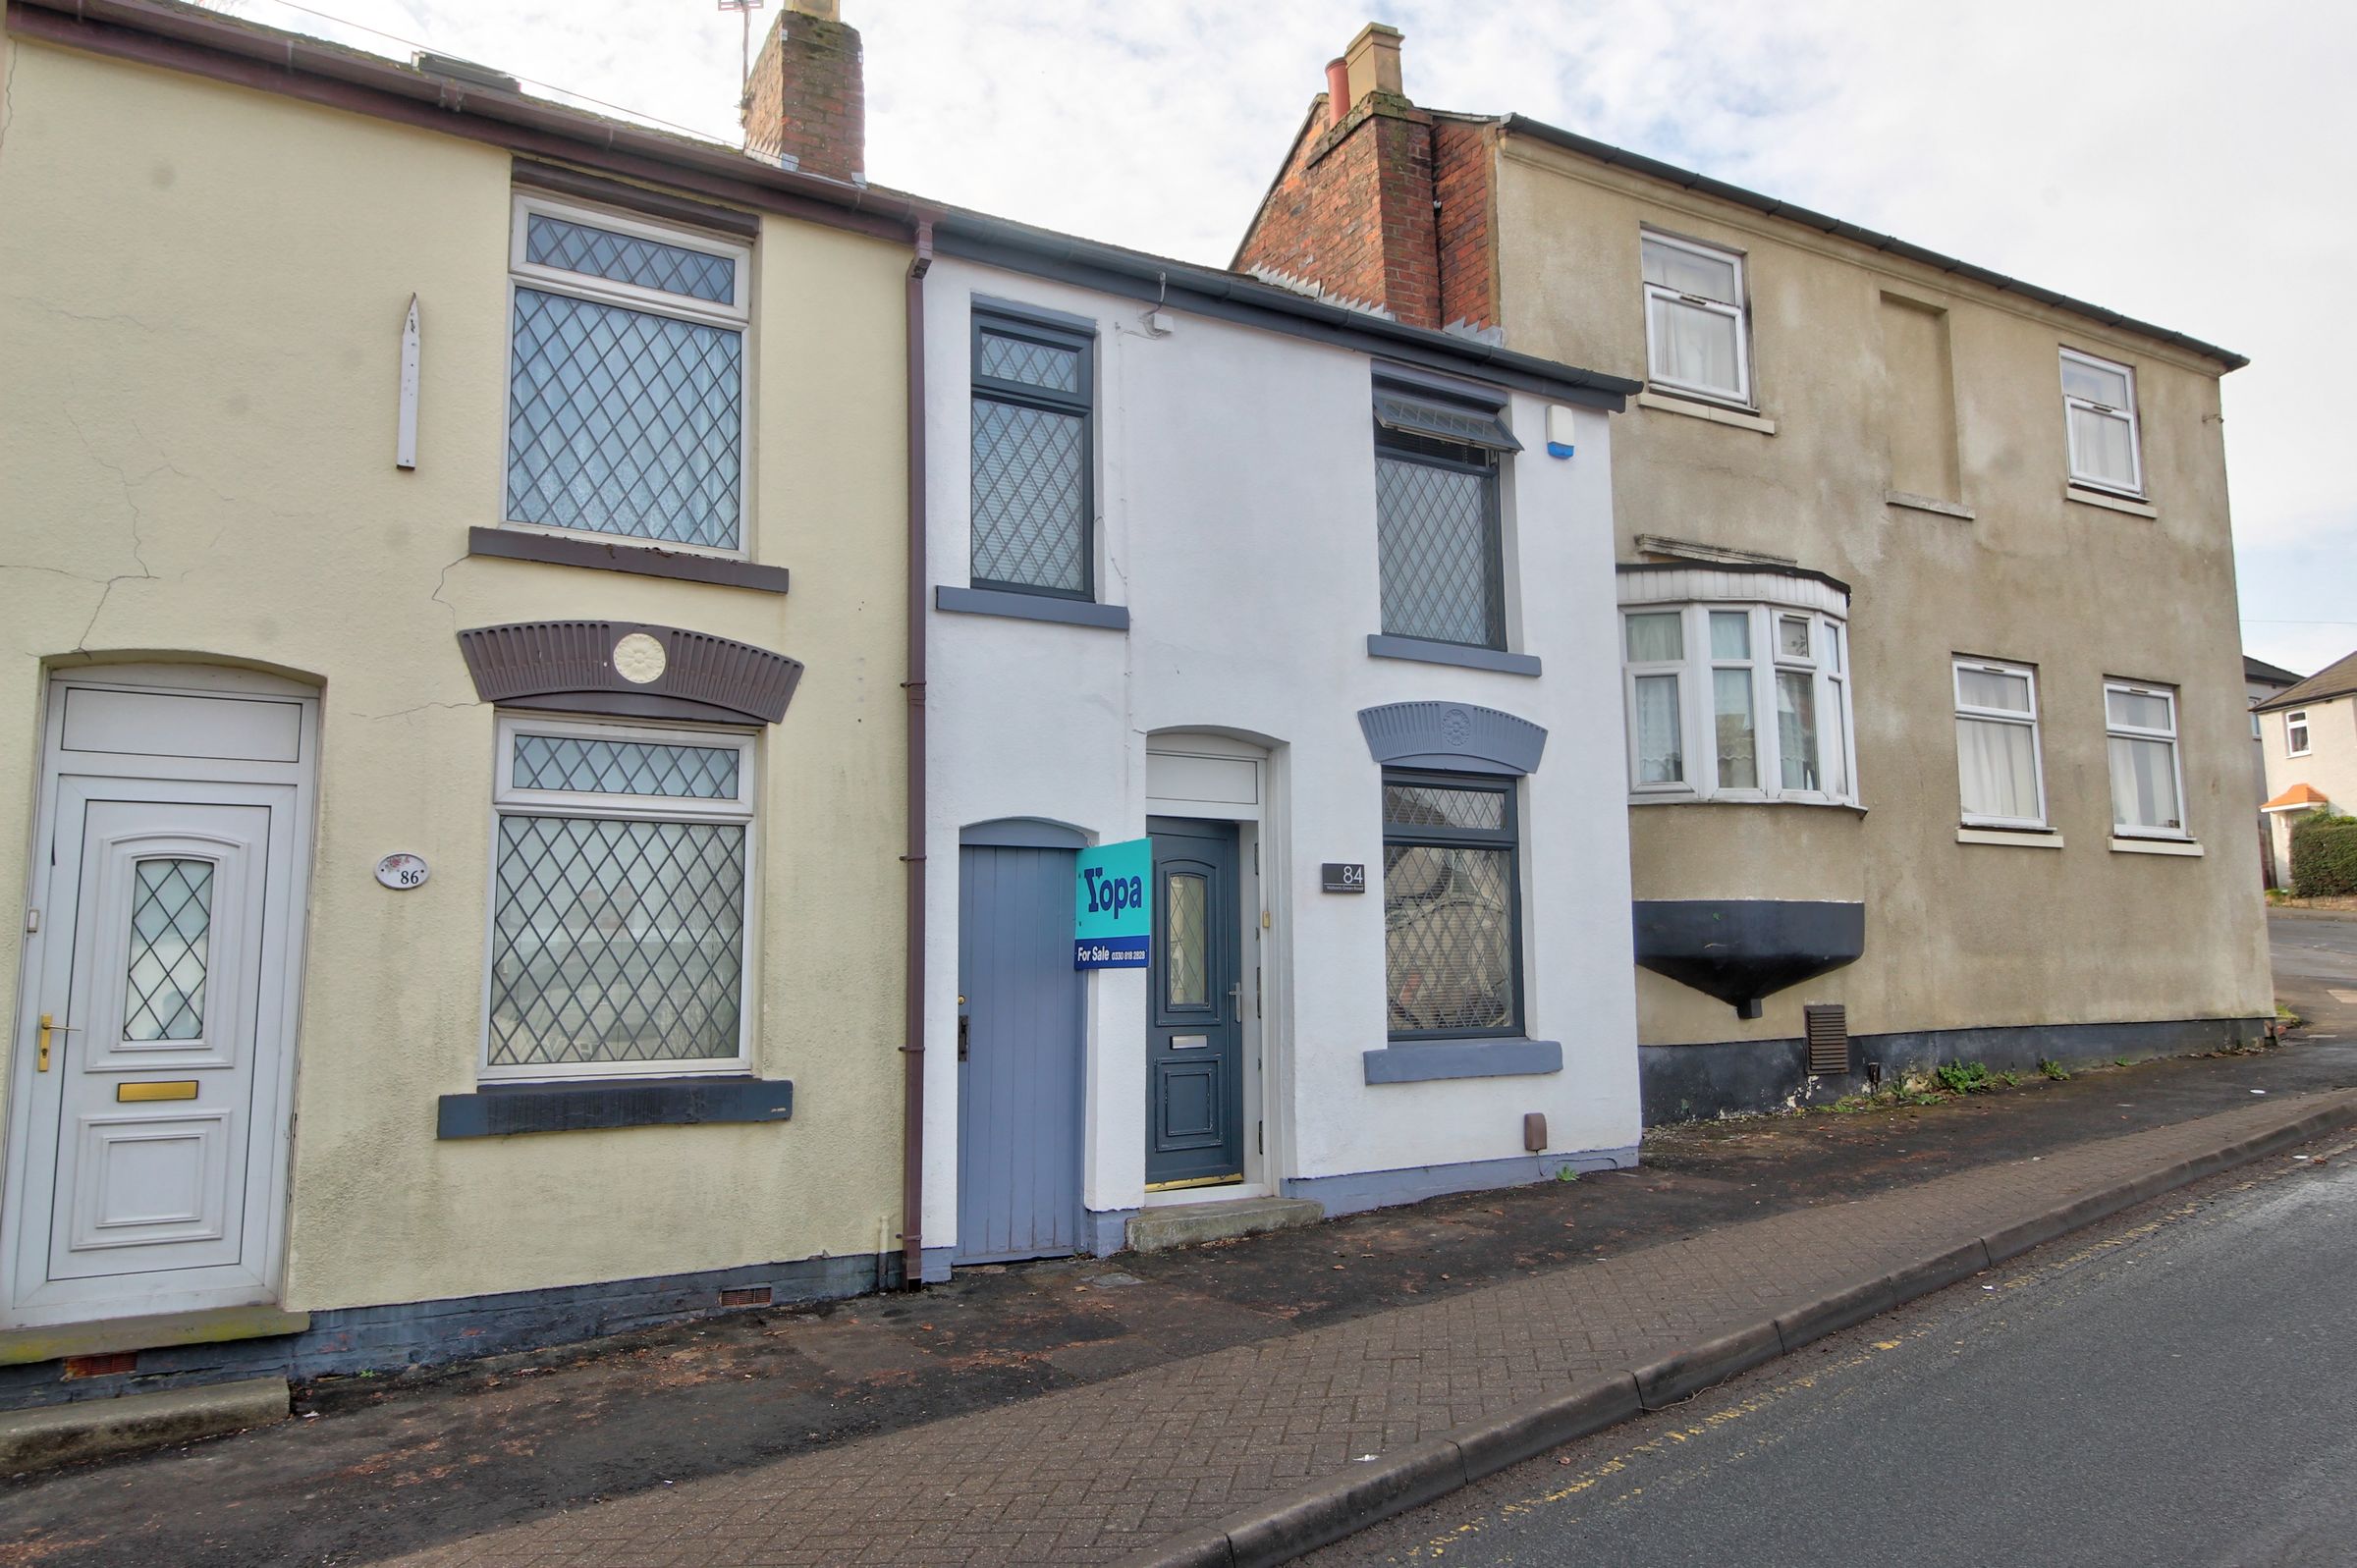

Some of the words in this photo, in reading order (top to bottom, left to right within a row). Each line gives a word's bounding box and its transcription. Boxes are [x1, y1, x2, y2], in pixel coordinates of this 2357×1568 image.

[401, 870, 418, 885] 86
[1343, 865, 1363, 884] 84
[1083, 866, 1142, 919] Yopa
[1077, 946, 1091, 961] For
[1092, 945, 1110, 961] Sale
